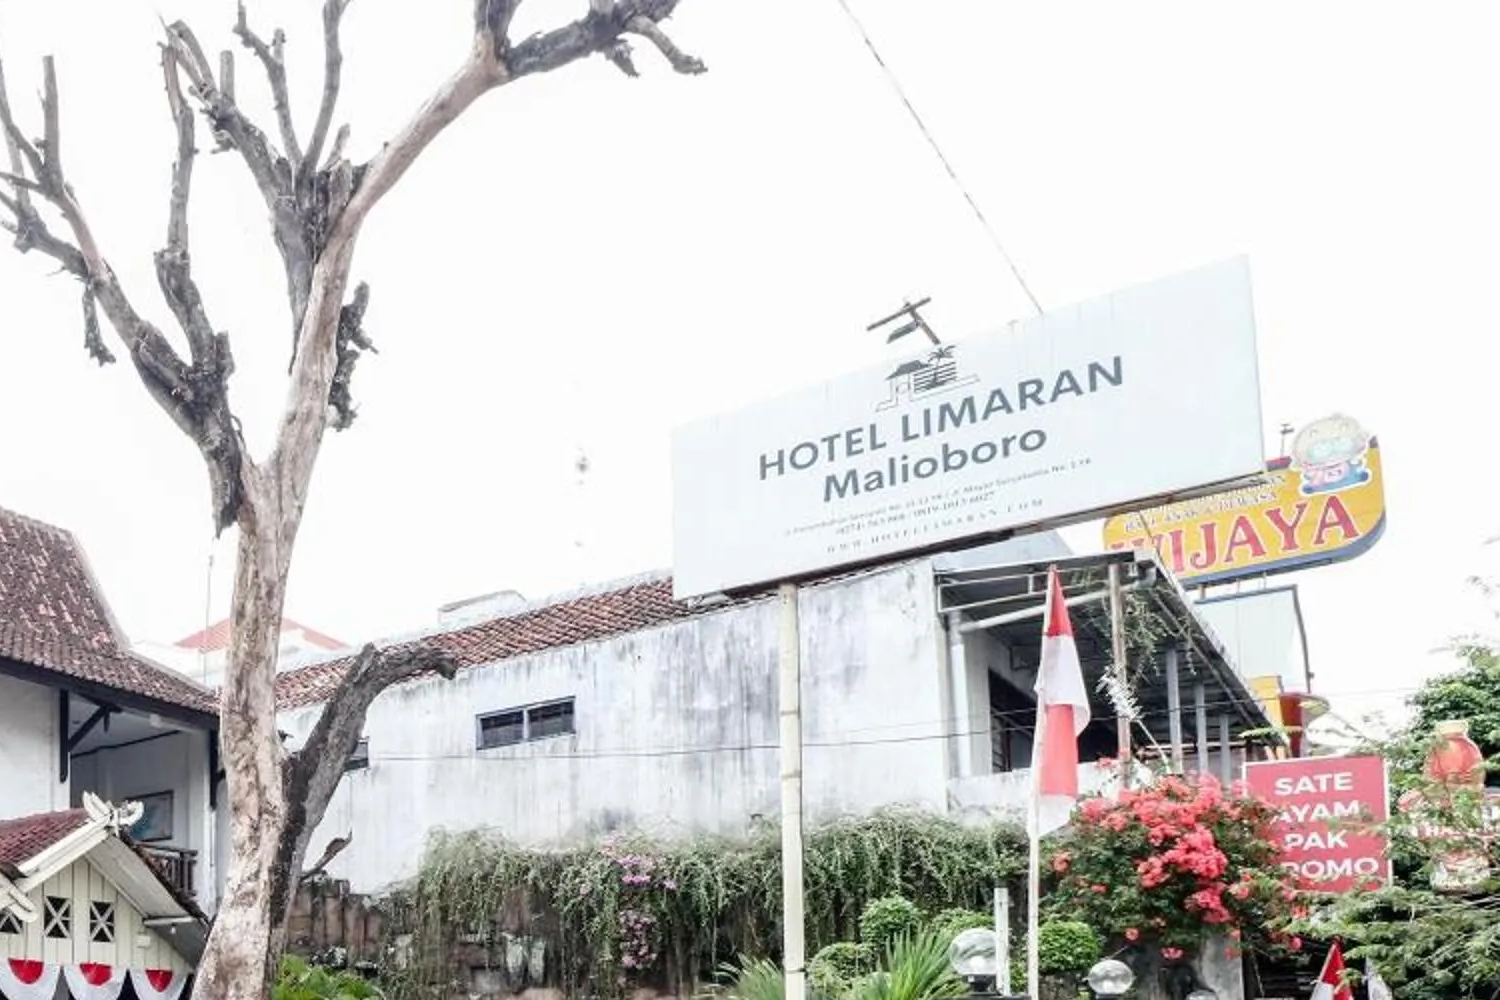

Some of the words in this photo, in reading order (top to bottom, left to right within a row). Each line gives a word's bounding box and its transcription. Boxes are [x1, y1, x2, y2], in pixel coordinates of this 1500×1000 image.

[758, 423, 887, 481] HOTEL
[901, 355, 1124, 443] LIMARAN
[823, 428, 1047, 503] Malioboro
[1274, 771, 1354, 796] SATE
[1270, 800, 1360, 824] AYAM
[1284, 829, 1348, 851] PAK
